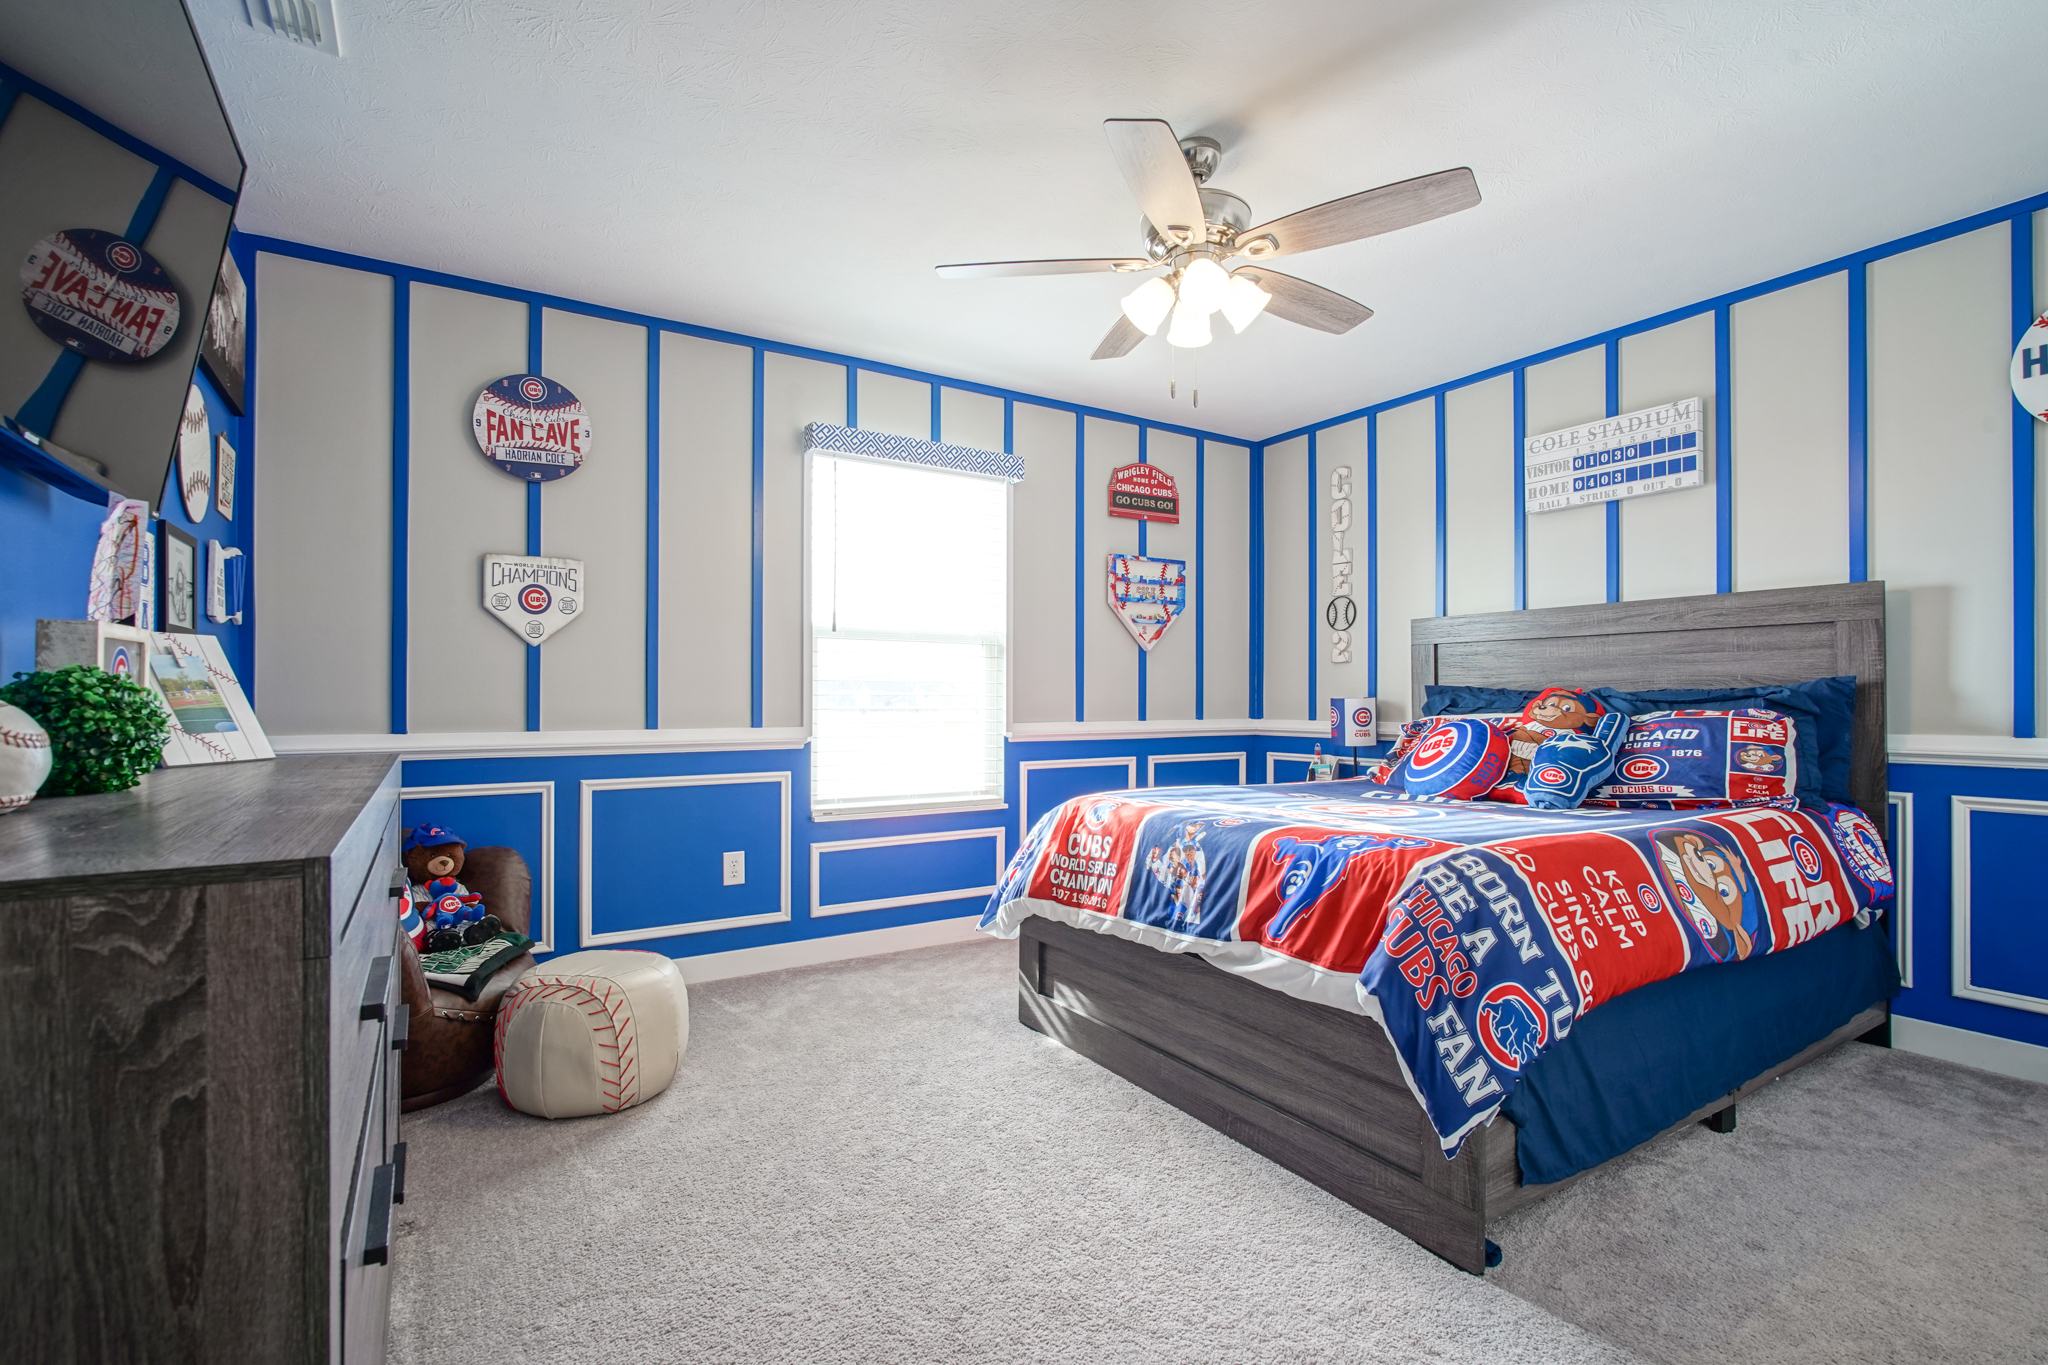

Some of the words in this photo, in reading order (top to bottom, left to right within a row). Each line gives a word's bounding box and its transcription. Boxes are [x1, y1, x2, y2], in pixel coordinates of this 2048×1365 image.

[524, 381, 542, 398] CUBS
[475, 418, 482, 427] 9
[502, 408, 541, 423] Chicao
[1529, 430, 1581, 455] COLE
[1587, 403, 1692, 442] STADIUM
[486, 408, 524, 446] FAN
[531, 418, 581, 454] CAVE
[584, 430, 590, 438] 3
[504, 448, 542, 462] HADRIAN
[546, 452, 566, 465] COLE
[1526, 459, 1571, 479] VISITOR
[1574, 458, 1582, 468] 0
[1589, 456, 1594, 466] 1
[1600, 453, 1608, 463] 0
[1614, 450, 1622, 460] 3
[1626, 448, 1635, 458] 0
[1116, 482, 1151, 494] CHICAGO
[1152, 488, 1173, 498] CUBS
[1118, 466, 1150, 480] WRIGLEY
[1152, 470, 1172, 486] FIELD
[1528, 481, 1570, 500] HOME
[1574, 480, 1582, 490] 0
[1588, 478, 1595, 487] 4
[1601, 475, 1608, 485] 0
[1614, 472, 1622, 482] 3
[1116, 495, 1130, 505] GO
[1132, 497, 1156, 508] CUBS
[1157, 500, 1174, 510] GO!
[1538, 499, 1563, 510] BALL
[1579, 488, 1618, 503] STRIKE
[1643, 480, 1666, 492] OUT
[1331, 466, 1353, 597] COLE
[492, 562, 577, 593] CHAMPIONS
[524, 589, 547, 610] CUBS
[1331, 630, 1352, 664] 2
[1356, 710, 1370, 724] CUBS
[1624, 729, 1700, 742] ICAGO
[1625, 742, 1662, 750] CUBS
[1734, 726, 1786, 740] LIFE
[1413, 728, 1455, 767] CUBS
[1471, 753, 1500, 787] CUBS
[1624, 759, 1658, 778] CUBS
[1612, 786, 1624, 794] GO
[1627, 786, 1655, 794] CUBS
[1068, 832, 1113, 860] CUBS
[1050, 853, 1087, 872] WORLD
[1088, 859, 1118, 878] SERIES
[1050, 868, 1114, 896] CHAMPION
[440, 896, 462, 913] CUBS
[1422, 863, 1478, 923] BE
[1461, 927, 1498, 967] A
[1494, 846, 1536, 872] GO
[1536, 881, 1582, 962] CUBS
[1554, 879, 1598, 950] SING
[1581, 892, 1604, 927] AND
[1582, 865, 1634, 949] CALM
[1602, 870, 1648, 937] KEEP
[1450, 853, 1546, 965] BORN
[1533, 967, 1574, 1041] TO
[1426, 1001, 1504, 1107] FAN
